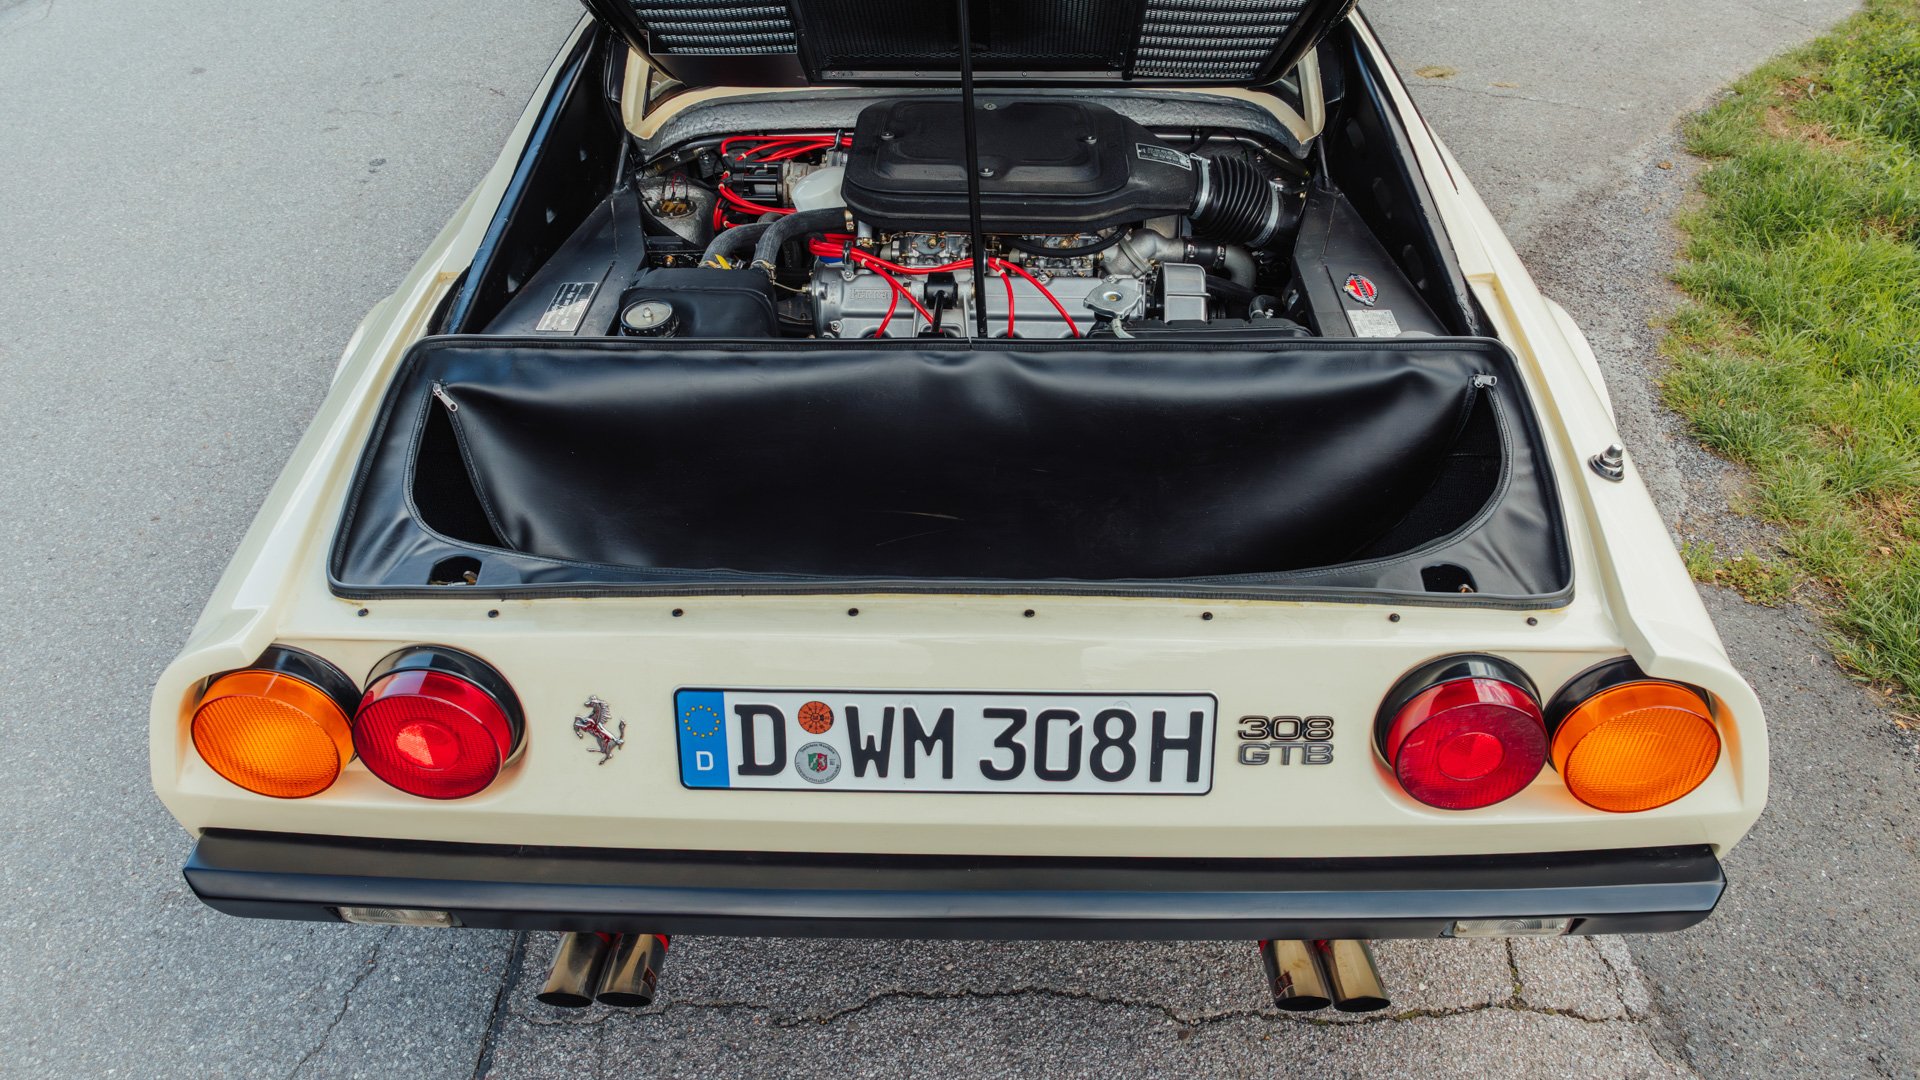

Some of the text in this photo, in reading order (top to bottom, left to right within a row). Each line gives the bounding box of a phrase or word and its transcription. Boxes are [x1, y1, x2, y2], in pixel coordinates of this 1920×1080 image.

[1238, 715, 1334, 741] 308
[734, 704, 787, 776] D
[845, 705, 955, 780] WM
[979, 708, 1205, 783] 308H
[1238, 741, 1334, 766] GTB
[696, 751, 714, 771] D
